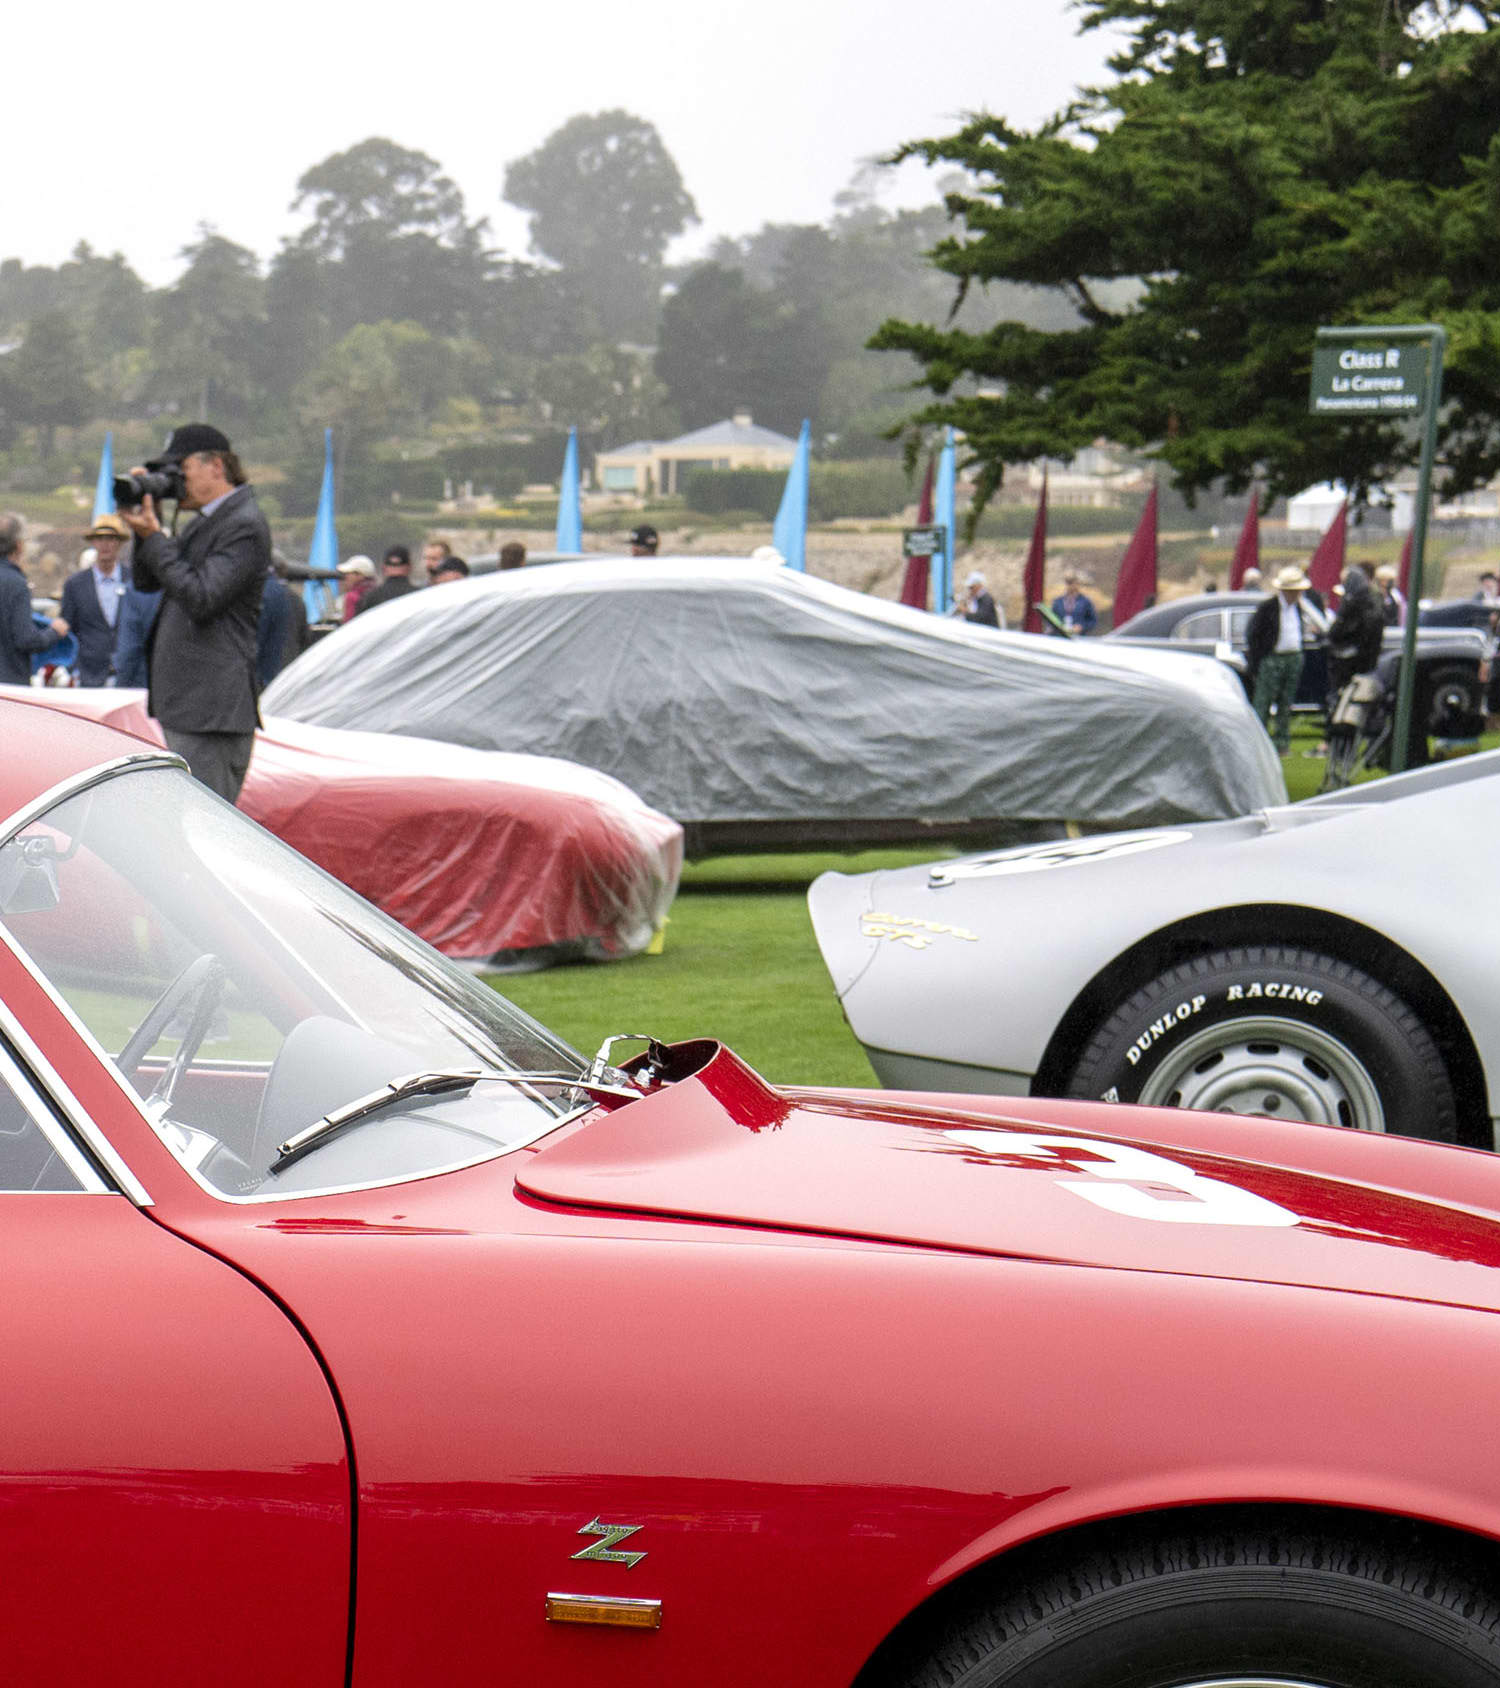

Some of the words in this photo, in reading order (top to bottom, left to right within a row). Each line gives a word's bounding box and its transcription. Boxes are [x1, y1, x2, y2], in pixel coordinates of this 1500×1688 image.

[1339, 349, 1384, 369] Class
[1385, 348, 1400, 368] R
[1126, 994, 1207, 1065] DUNLOP
[1227, 982, 1323, 1006] RACING
